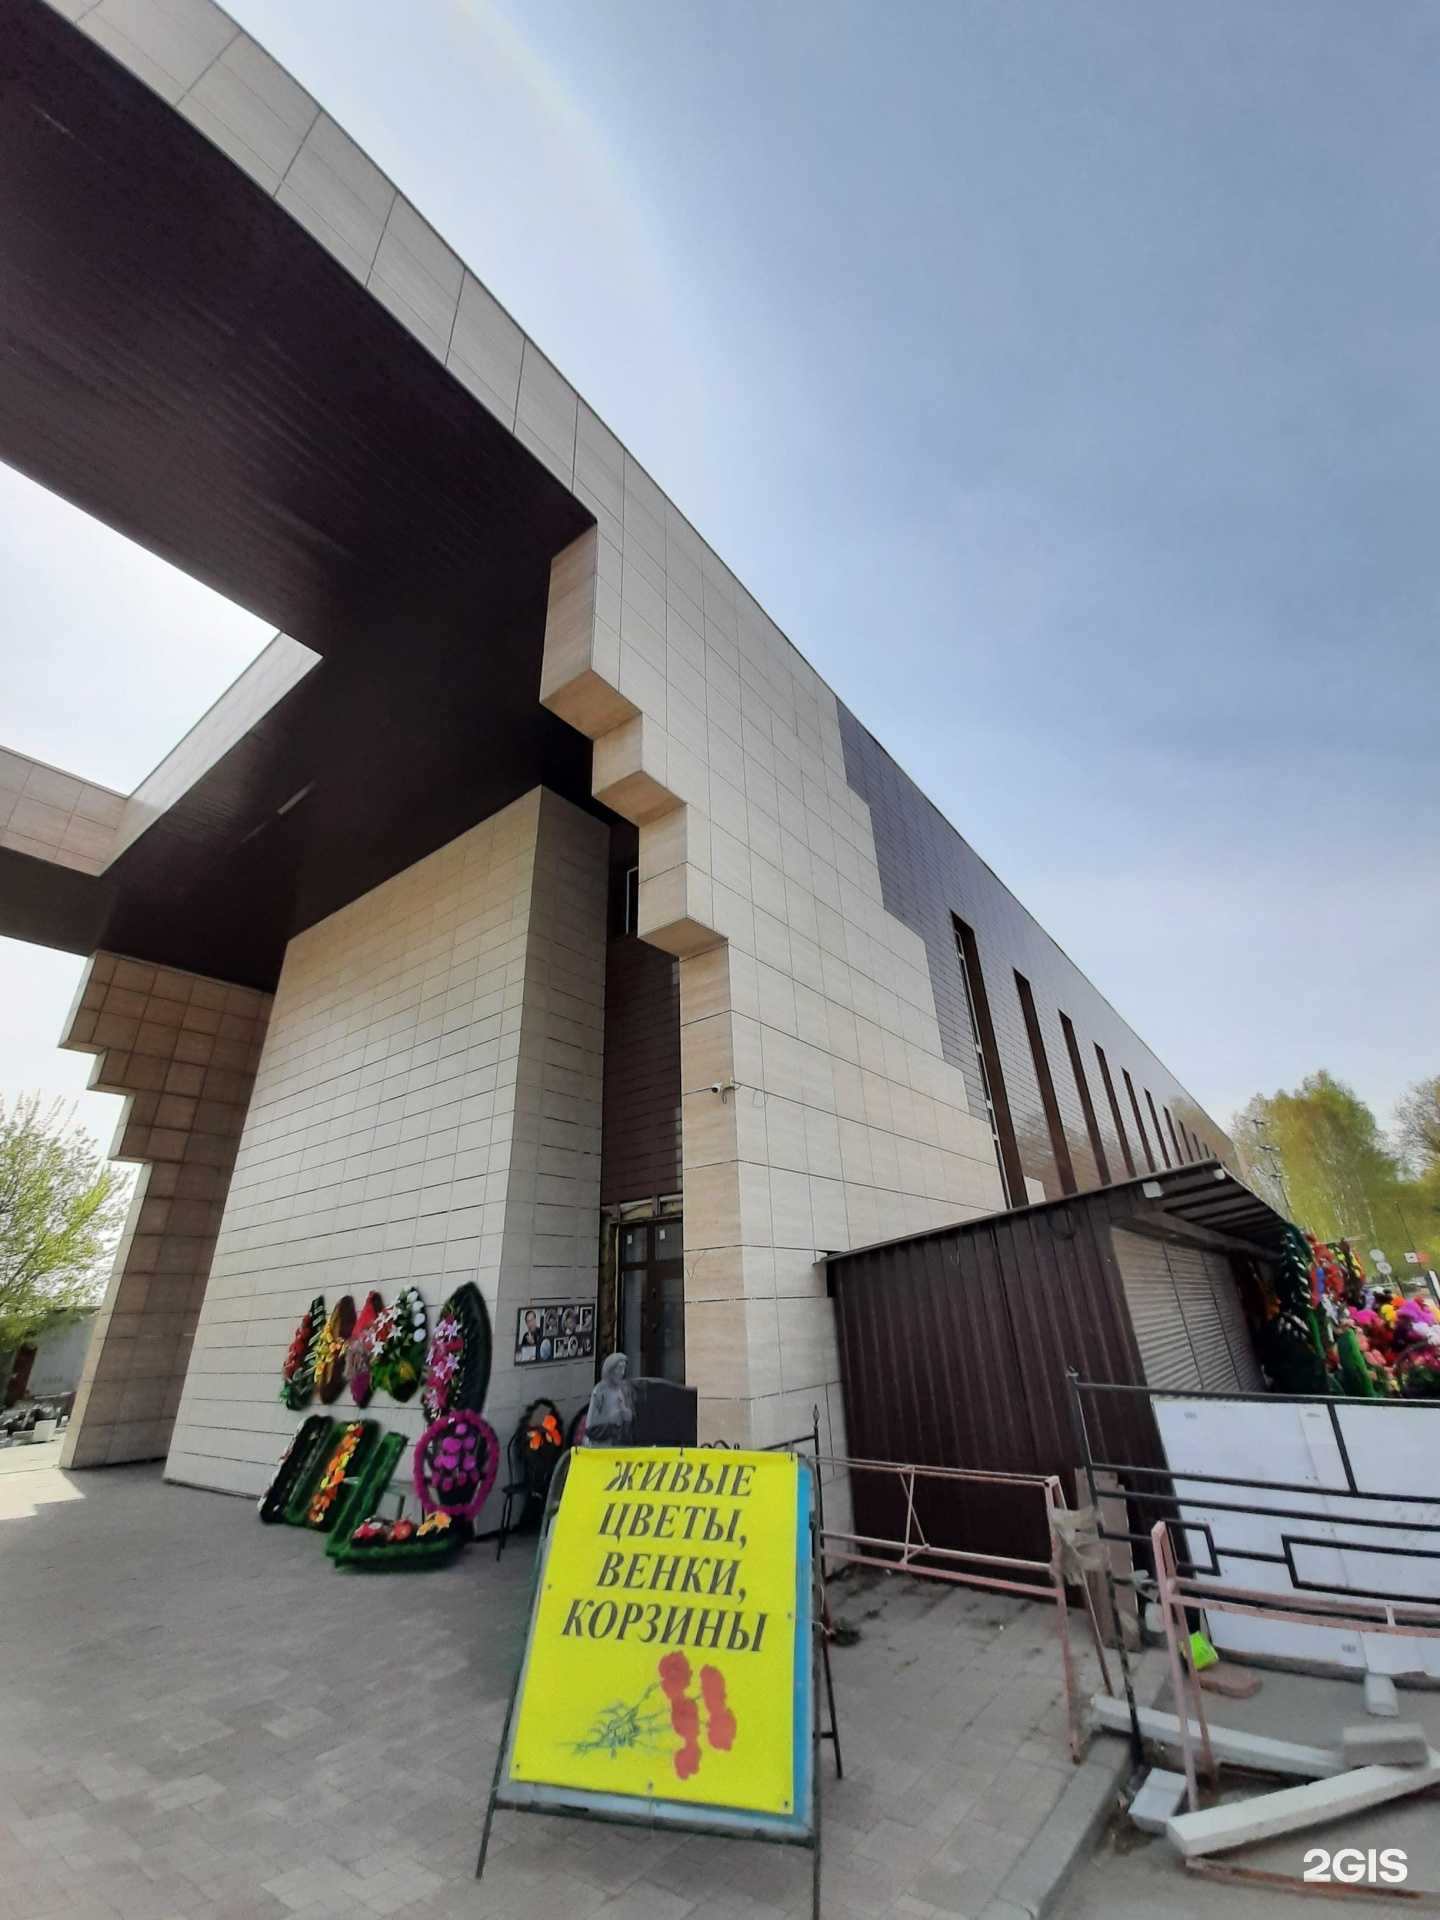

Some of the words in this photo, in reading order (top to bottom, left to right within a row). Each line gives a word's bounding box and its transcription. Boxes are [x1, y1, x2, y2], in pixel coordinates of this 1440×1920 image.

[604, 1461, 756, 1496] ЖИВЫЕ
[598, 1502, 748, 1550] ЦВЕТЫ,
[596, 1551, 747, 1604] ВЕНКИ,
[561, 1598, 768, 1652] КОРЗИНЫ
